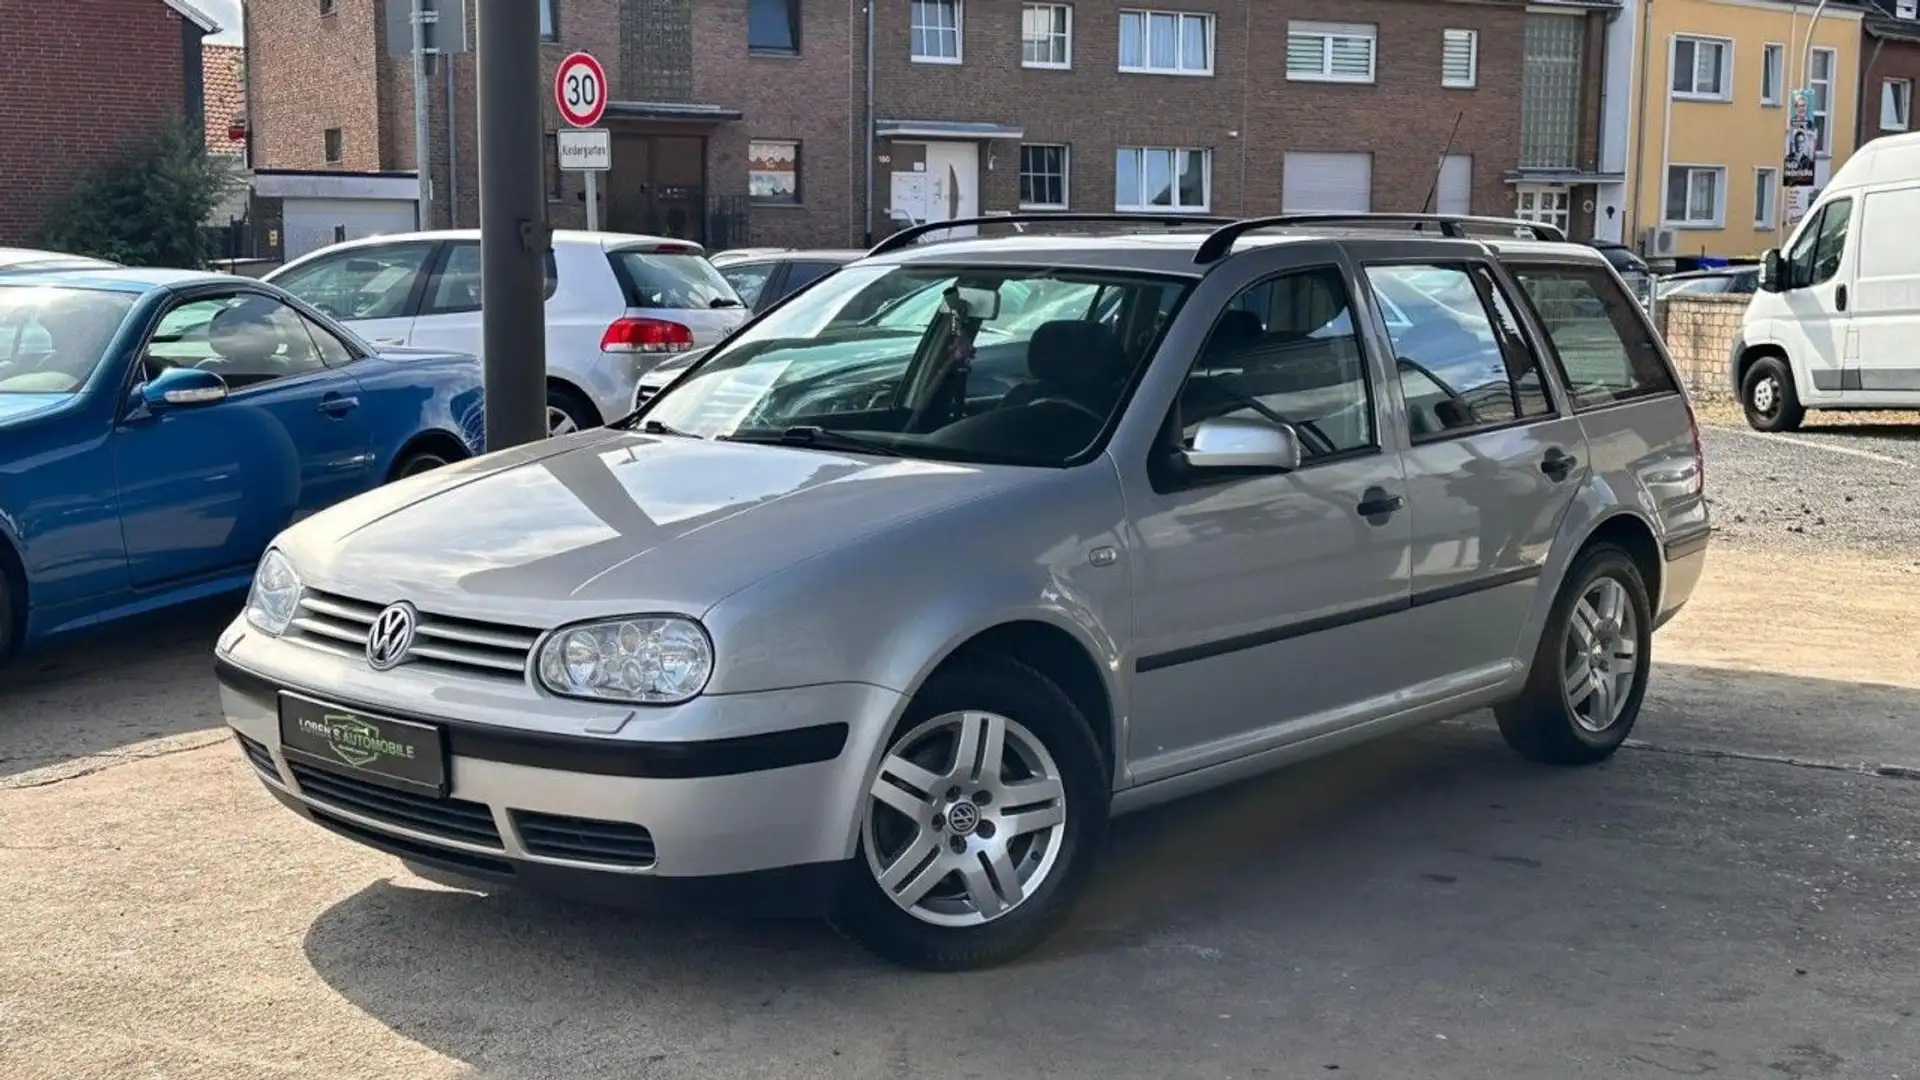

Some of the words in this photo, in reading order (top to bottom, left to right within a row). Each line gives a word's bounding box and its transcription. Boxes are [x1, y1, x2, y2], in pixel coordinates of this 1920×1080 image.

[567, 74, 595, 106] 30
[562, 144, 606, 159] Kindergarten
[343, 732, 415, 759] AUTOMOBILE
